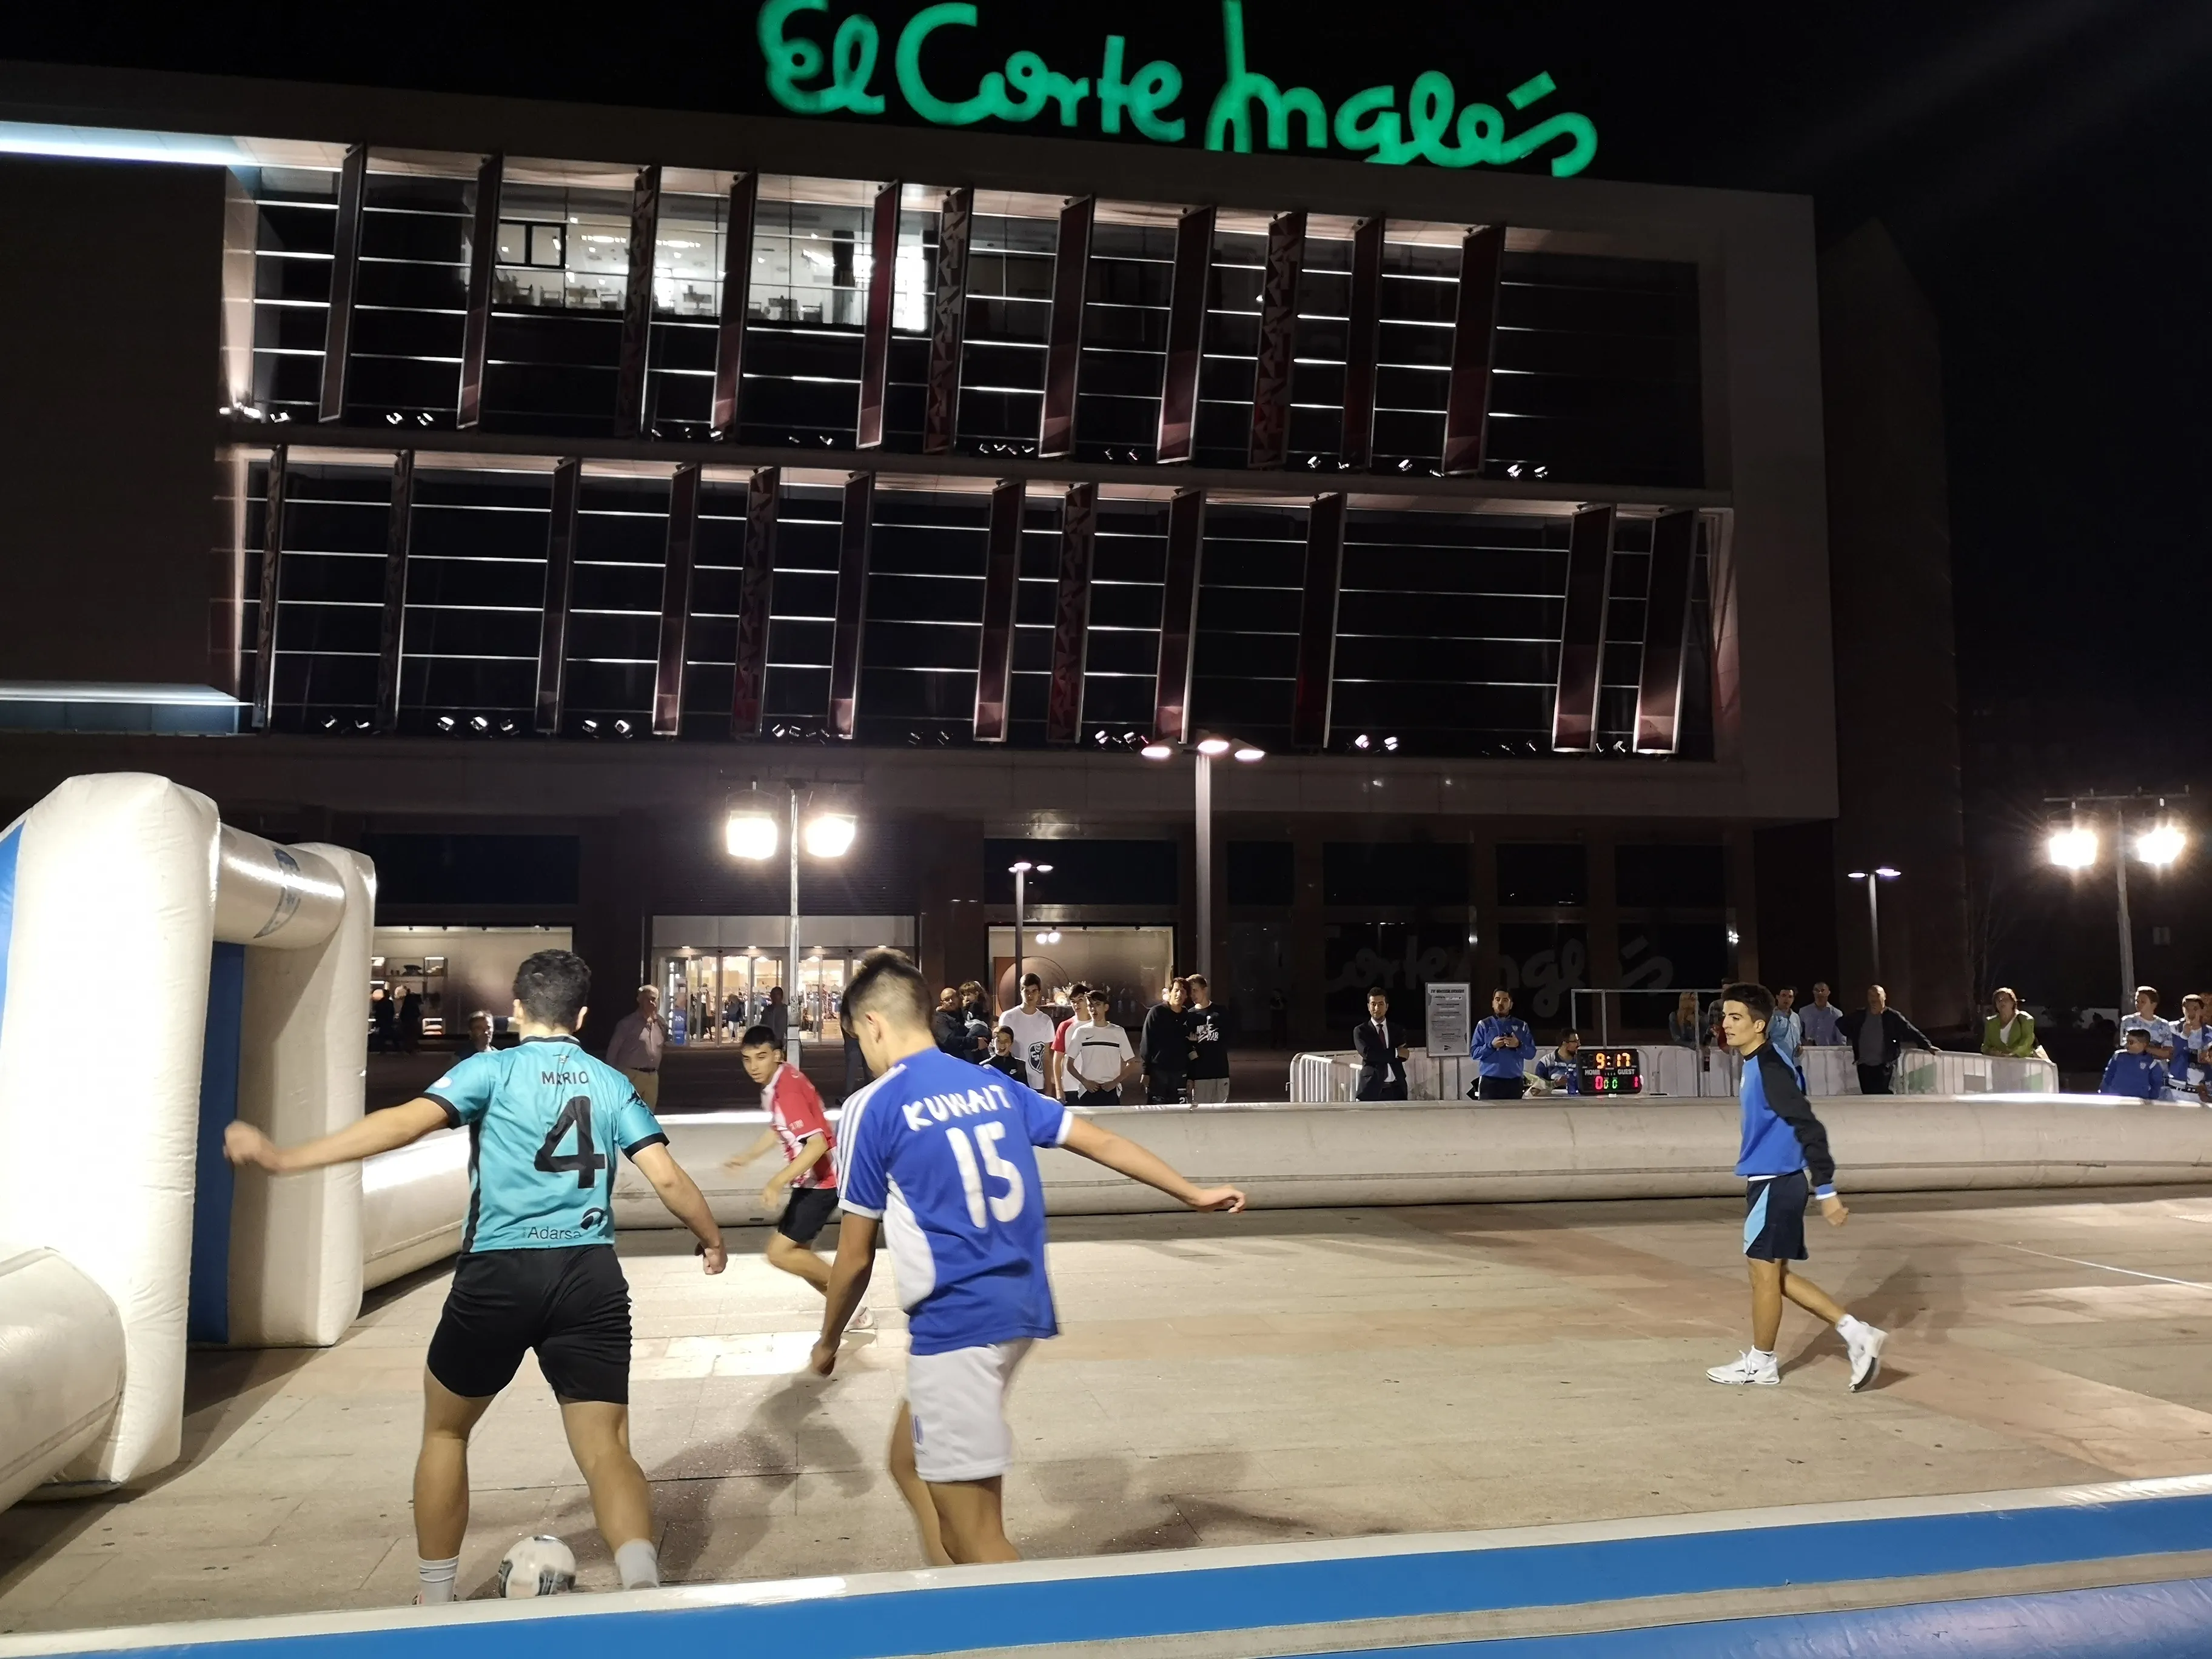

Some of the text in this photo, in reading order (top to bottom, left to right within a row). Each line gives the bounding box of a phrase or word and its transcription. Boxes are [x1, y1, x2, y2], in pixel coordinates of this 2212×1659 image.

[756, 0, 885, 115] El
[895, 1, 1186, 142] Corte
[1322, 934, 1448, 993] orte
[541, 1071, 589, 1085] MARIO
[1595, 1052, 1631, 1069] 9:17
[1595, 1076, 1603, 1090] 0
[902, 1085, 1012, 1132] KUWAIT
[534, 1095, 606, 1189] 4
[944, 1121, 1025, 1229] 15
[528, 1226, 581, 1240] Adarsa
